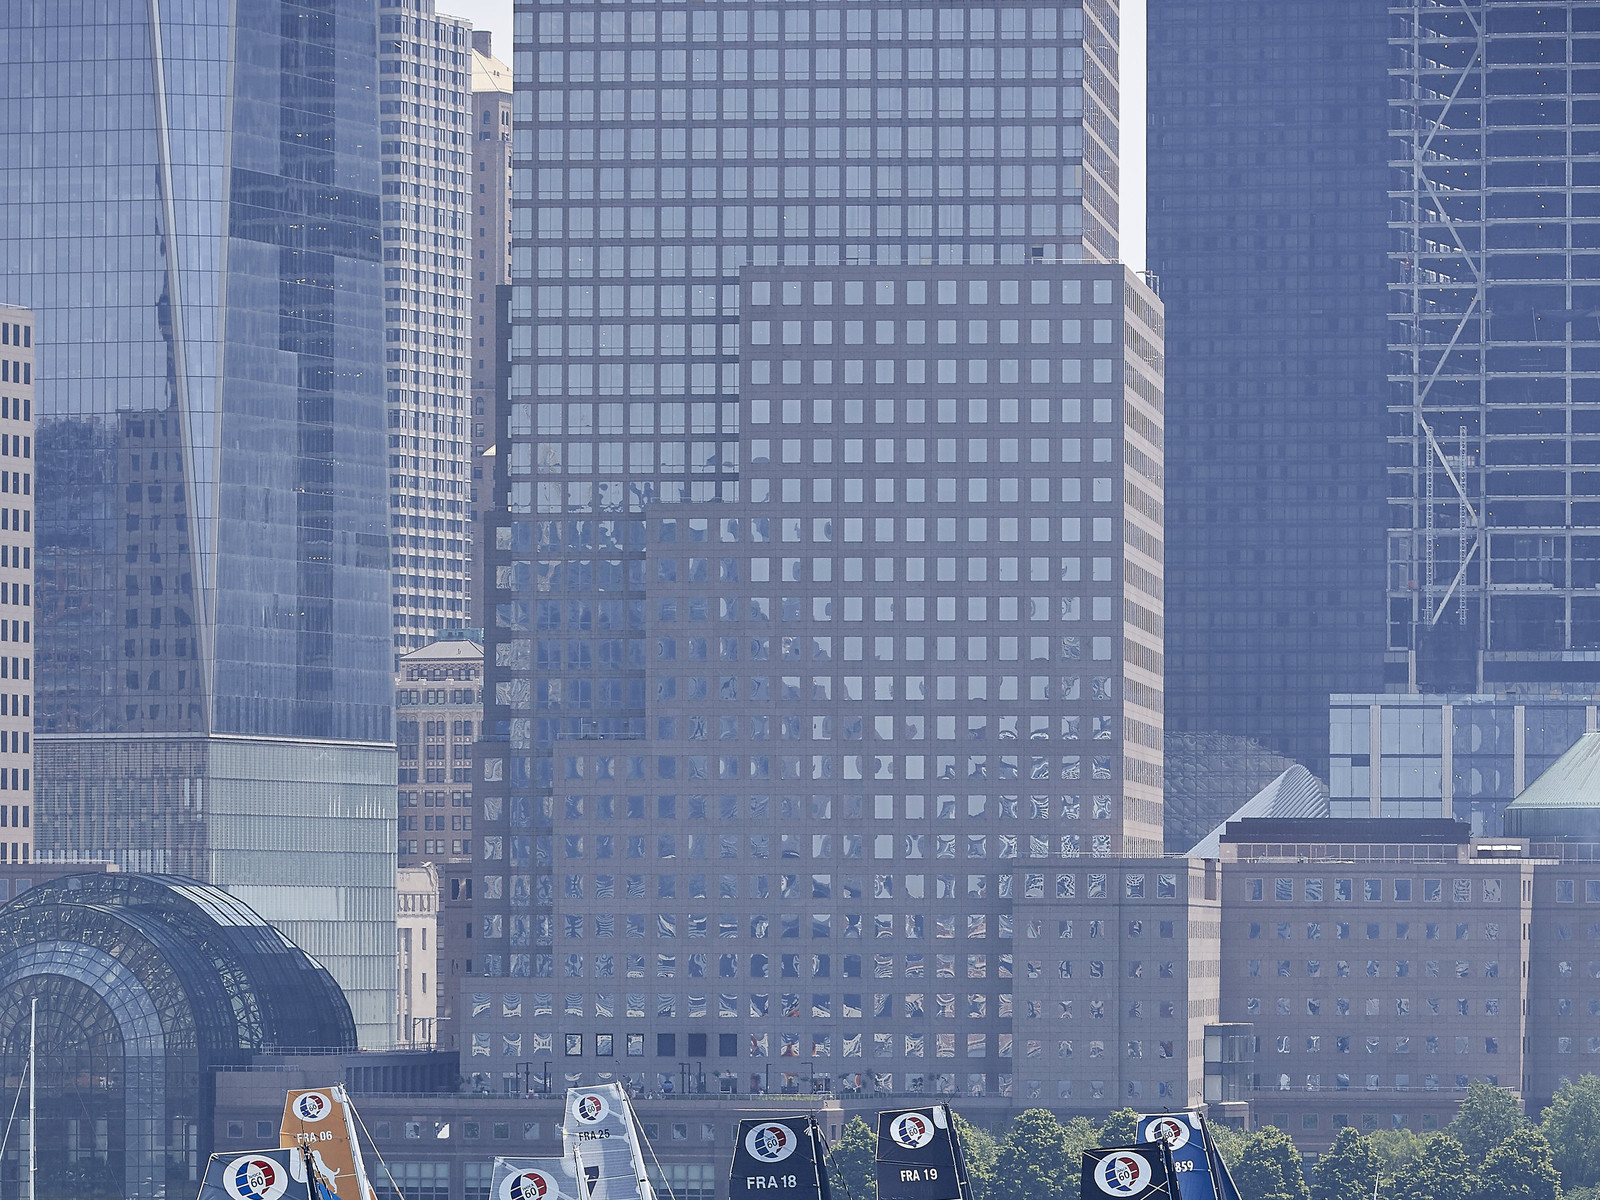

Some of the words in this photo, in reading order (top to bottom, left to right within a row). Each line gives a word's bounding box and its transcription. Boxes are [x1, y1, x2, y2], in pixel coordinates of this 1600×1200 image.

[296, 1132, 317, 1143] FRA
[319, 1131, 333, 1141] 06
[578, 1131, 597, 1141] FRA
[598, 1129, 611, 1139] 25
[908, 1127, 918, 1136] 60
[1163, 1130, 1174, 1140] 60
[766, 1139, 778, 1149] 60
[1174, 1160, 1194, 1173] 859
[900, 1170, 921, 1182] FRA
[924, 1168, 938, 1180] 19
[1118, 1170, 1130, 1182] 60
[250, 1176, 264, 1188] 60
[746, 1176, 779, 1190] FRA
[780, 1174, 797, 1188] 18
[524, 1187, 537, 1199] 60
